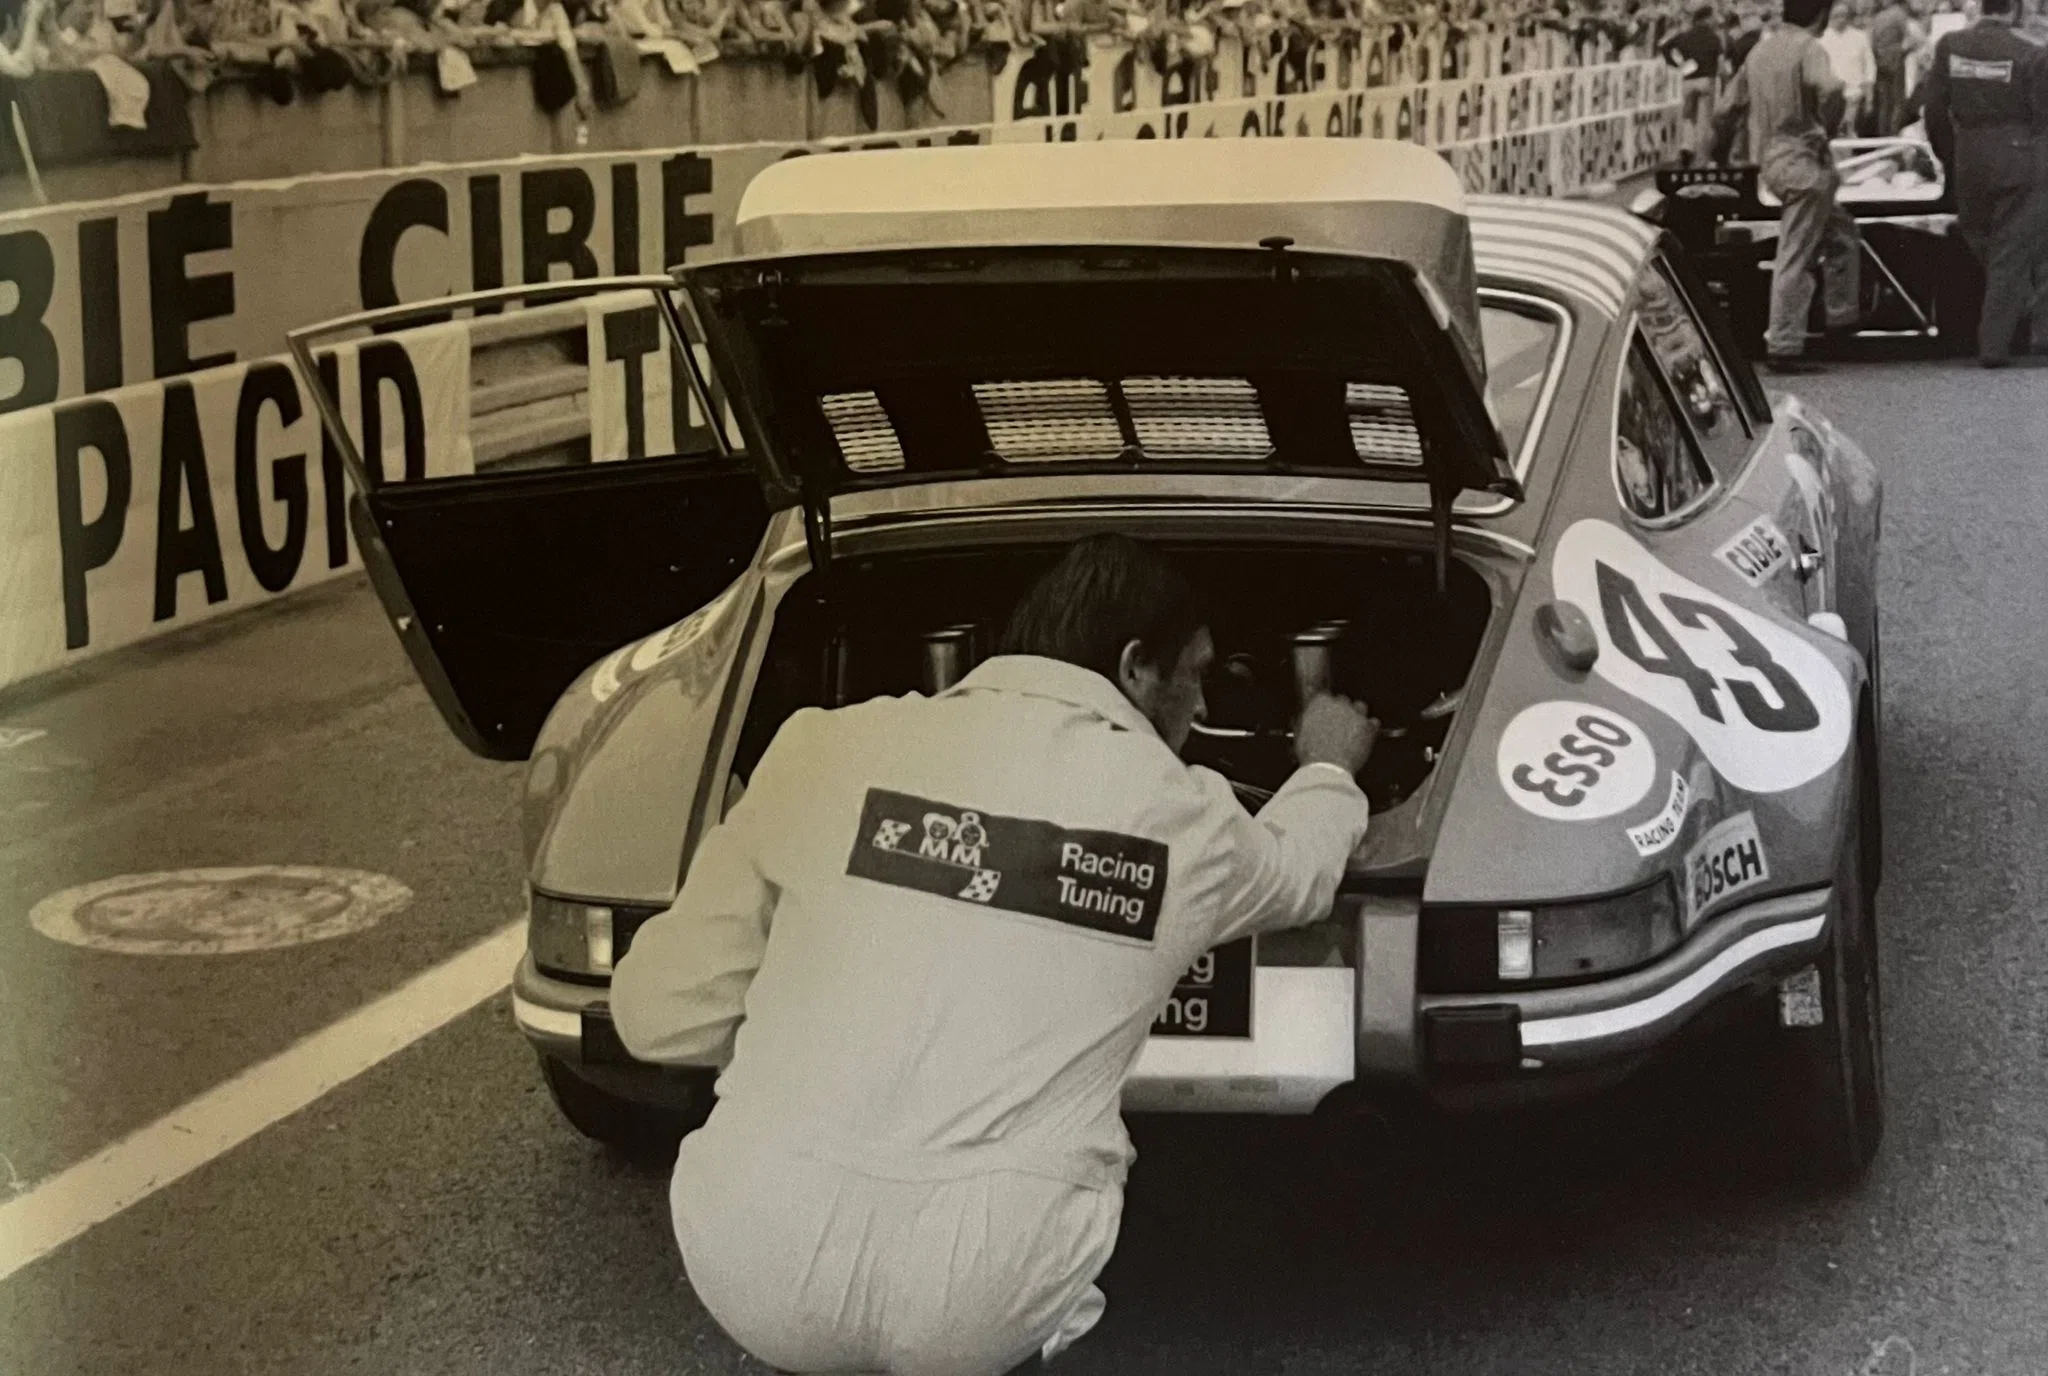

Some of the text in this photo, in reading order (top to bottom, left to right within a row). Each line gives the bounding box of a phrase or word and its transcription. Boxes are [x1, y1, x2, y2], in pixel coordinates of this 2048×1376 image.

[53, 340, 426, 650] PAGID
[1595, 559, 1820, 732] 43
[1512, 715, 1632, 807] ESSO
[1057, 875, 1145, 924] Tuning
[1060, 842, 1156, 890] Racing
